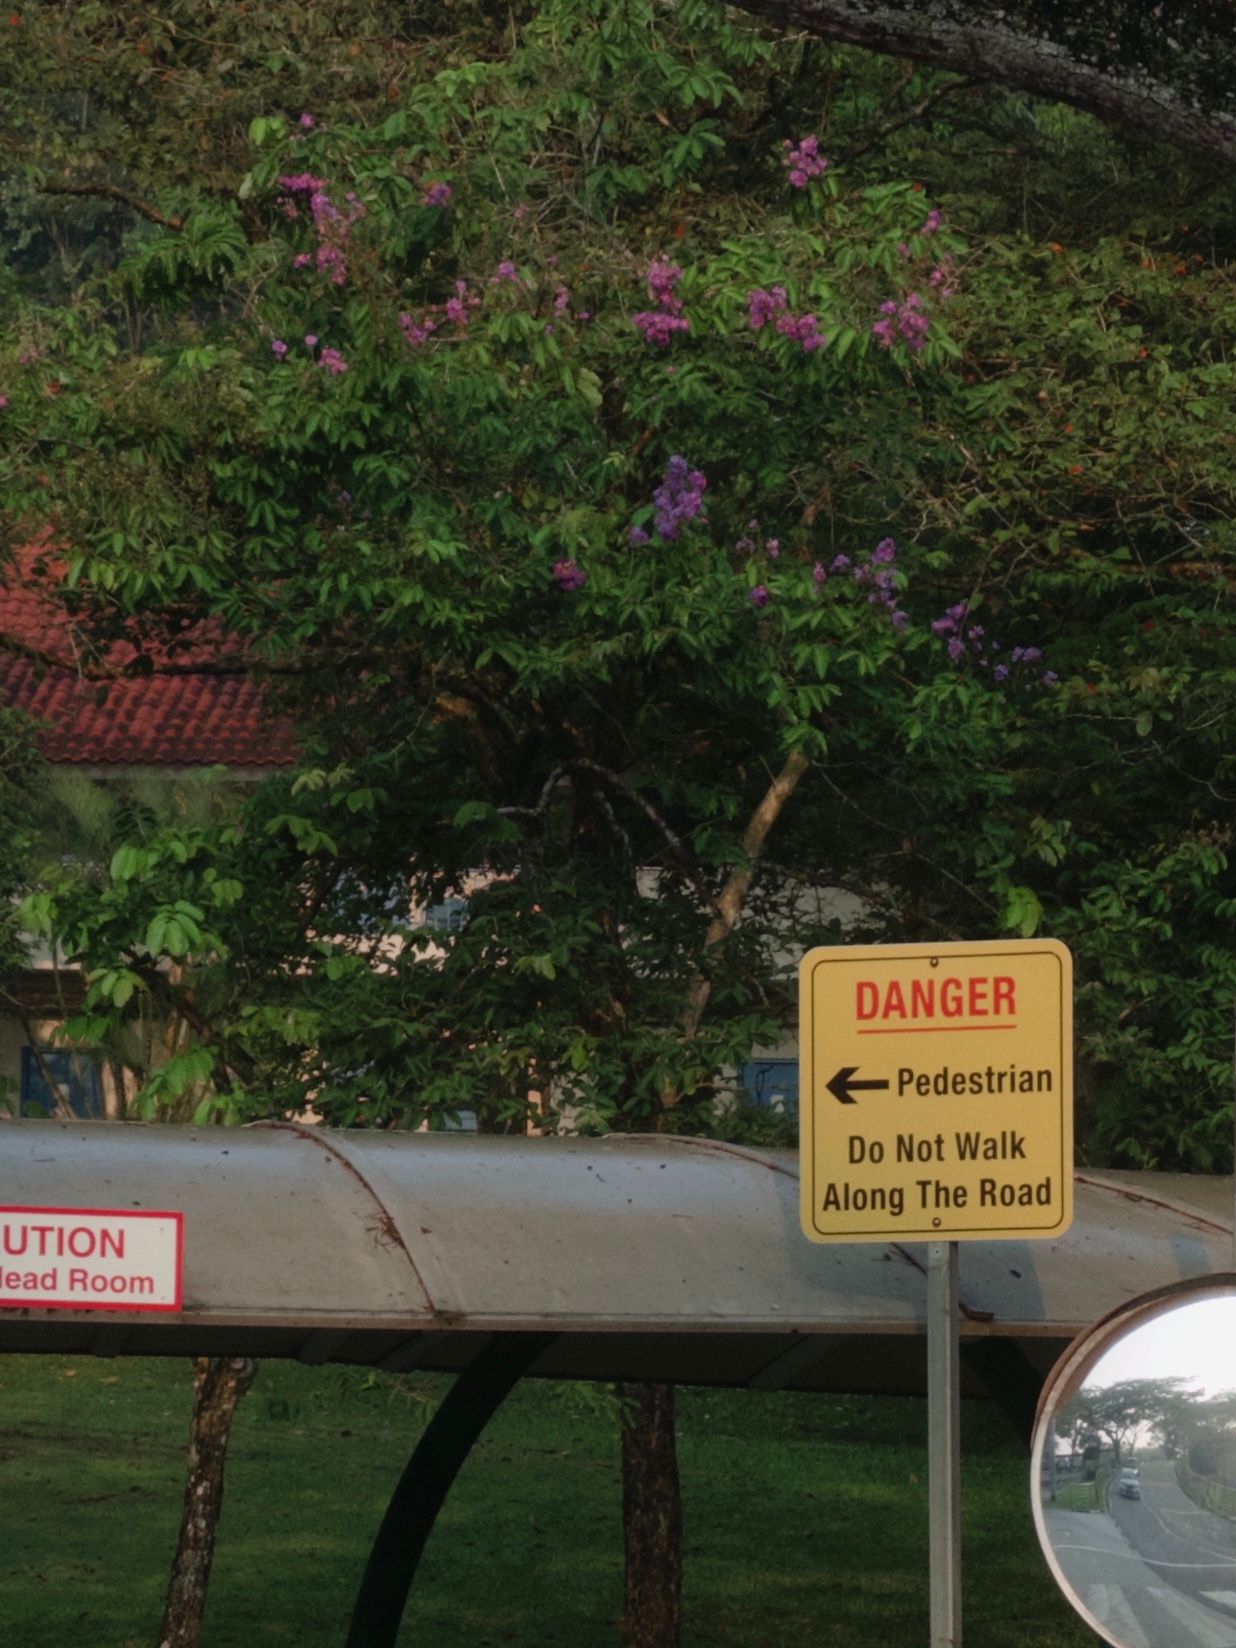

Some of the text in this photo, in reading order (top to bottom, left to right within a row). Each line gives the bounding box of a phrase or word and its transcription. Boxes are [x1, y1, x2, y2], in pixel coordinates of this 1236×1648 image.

[856, 976, 1017, 1021] DANGER
[898, 1064, 1053, 1097] Pedestrian
[848, 1131, 1027, 1164] Do Not Walk
[822, 1177, 1052, 1216] Along The Road
[0, 1265, 154, 1294] ead Room
